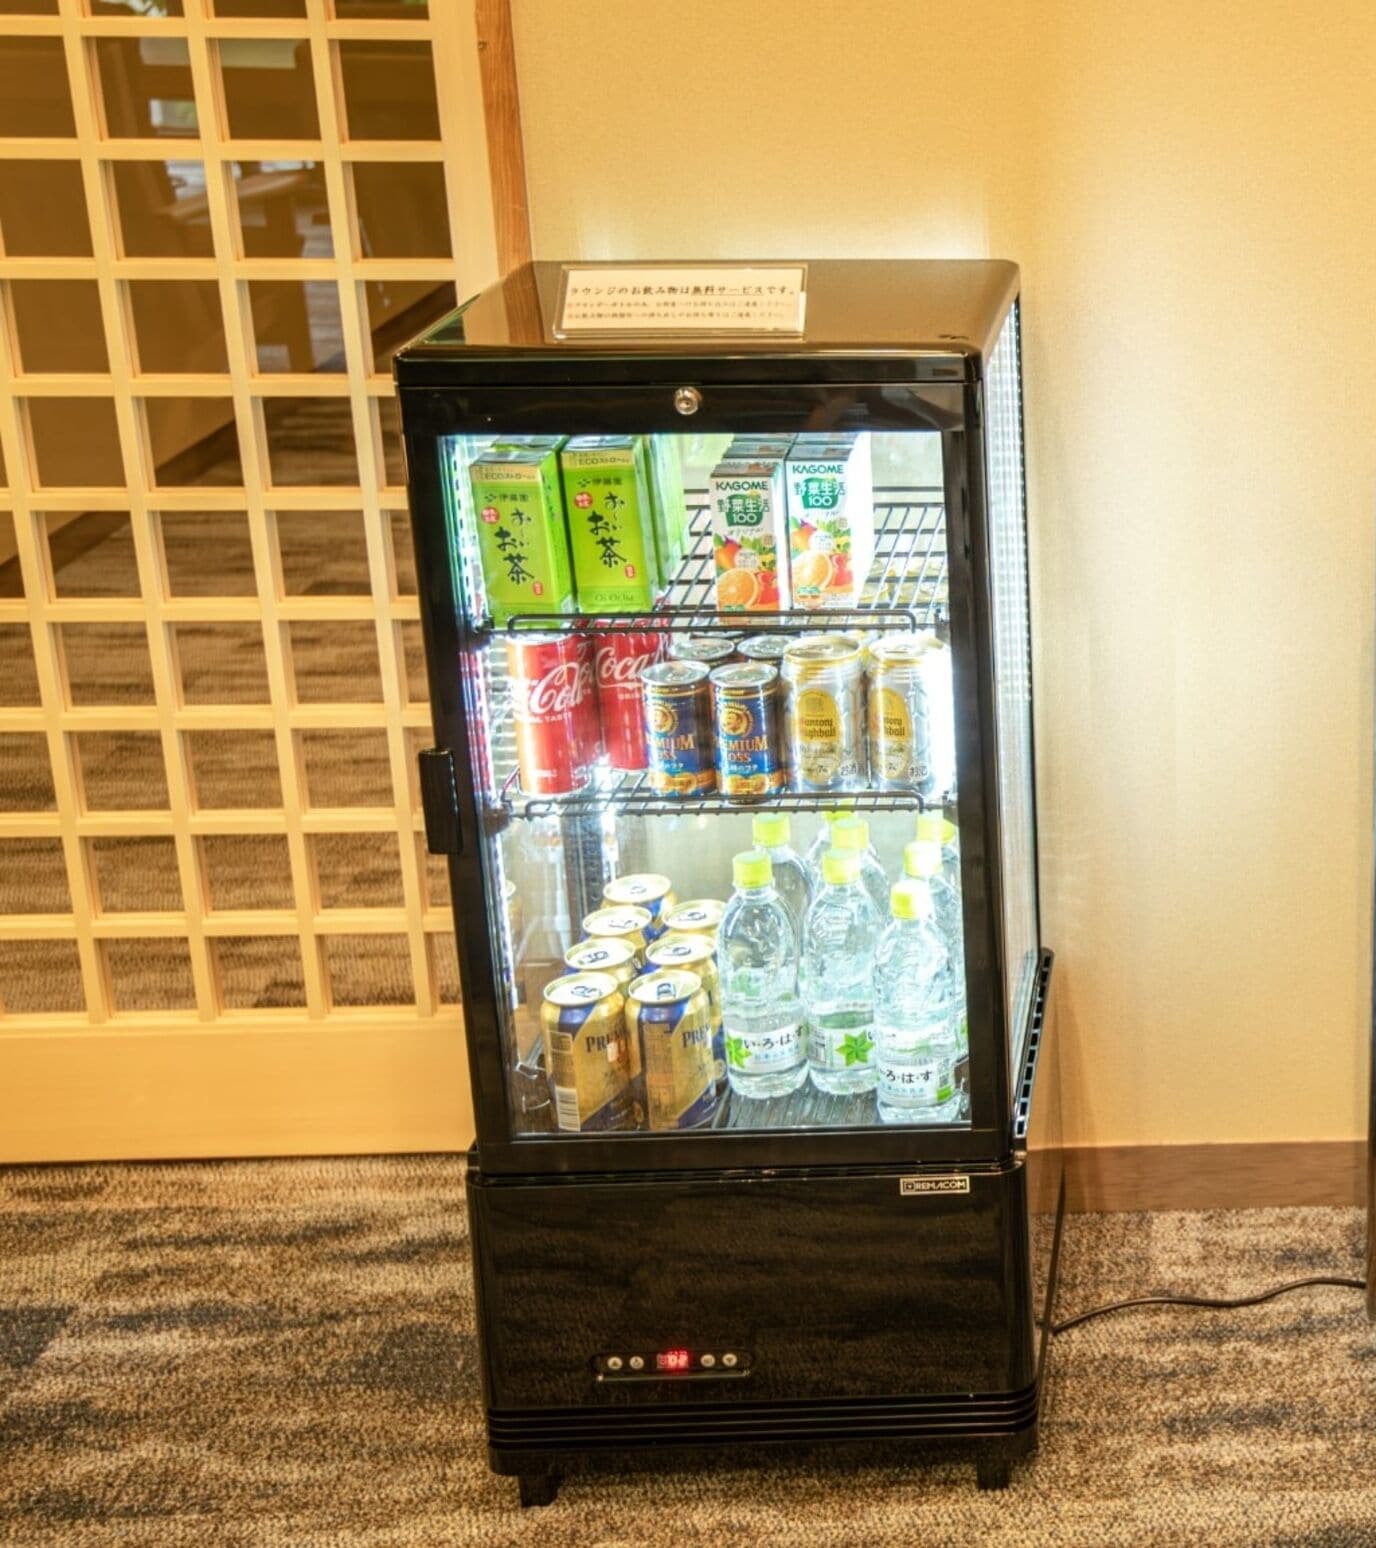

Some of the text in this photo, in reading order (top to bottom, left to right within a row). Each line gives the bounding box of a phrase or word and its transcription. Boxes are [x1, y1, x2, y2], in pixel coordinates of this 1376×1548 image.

[792, 464, 844, 474] KAGOME
[715, 481, 768, 491] KAGOME
[794, 482, 845, 496] 野菜生活
[717, 498, 770, 513] 野菜生活
[808, 495, 832, 506] 100
[732, 513, 757, 523] 100
